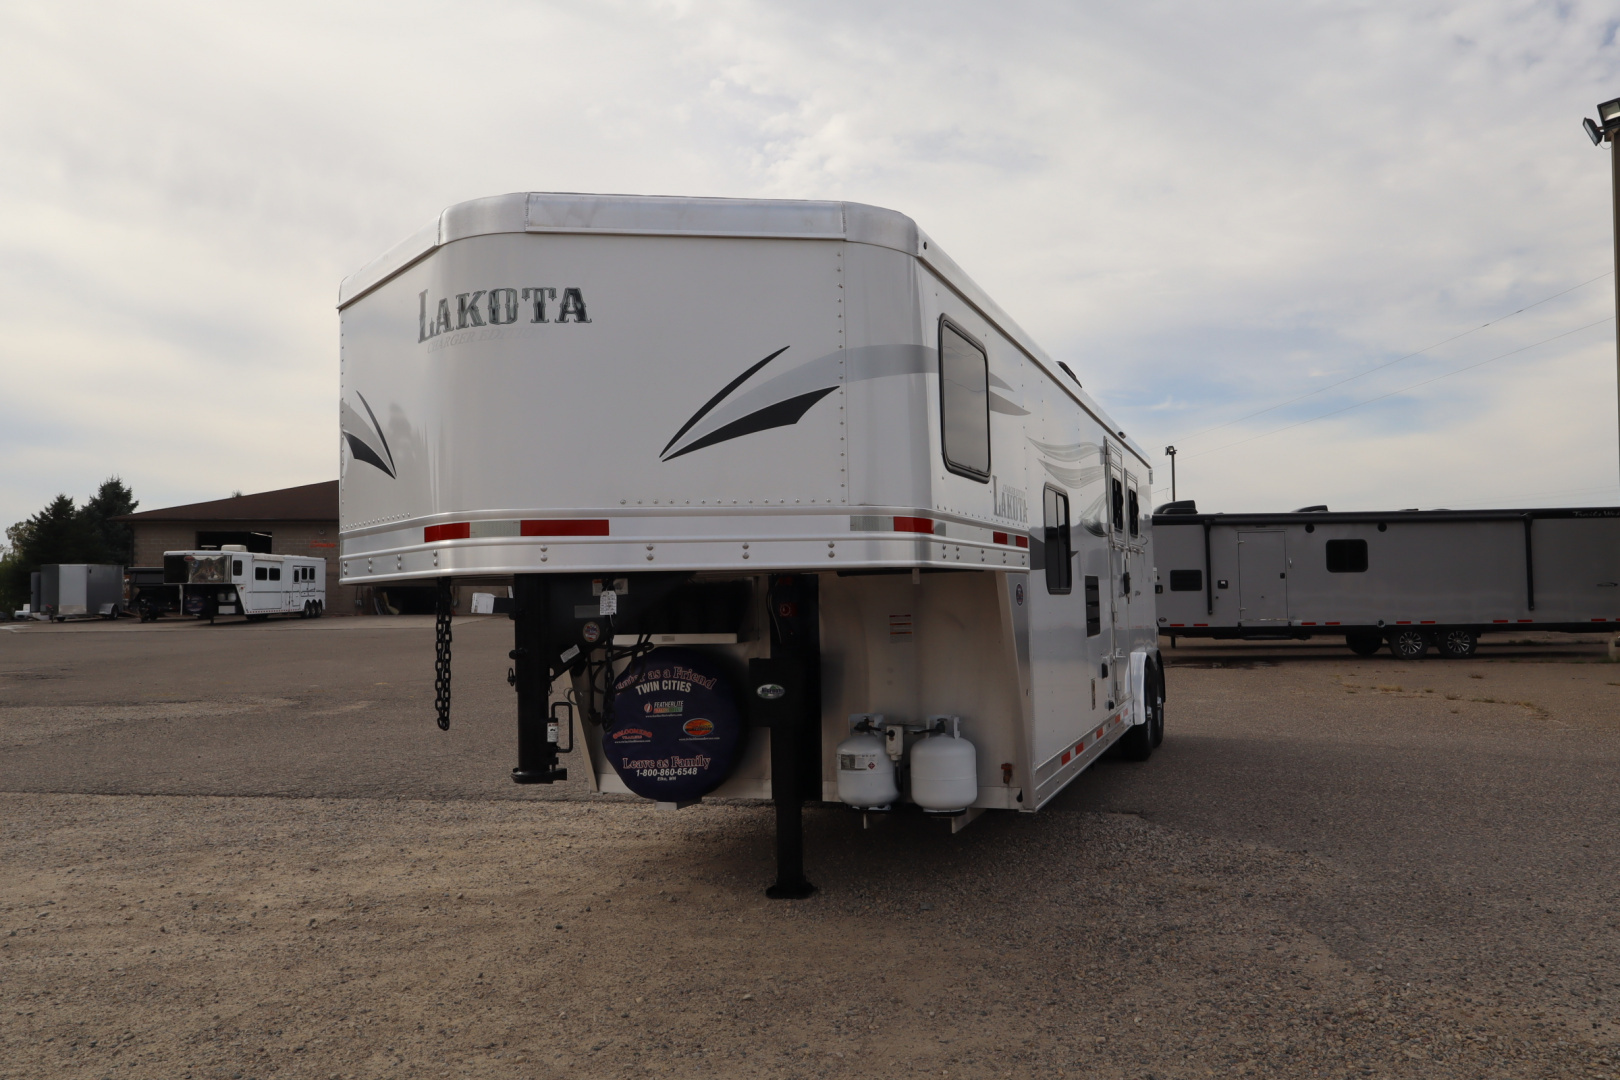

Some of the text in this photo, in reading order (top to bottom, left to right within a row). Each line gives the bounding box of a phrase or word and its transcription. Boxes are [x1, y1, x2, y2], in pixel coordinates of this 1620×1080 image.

[418, 287, 593, 343] LAKOTA
[992, 475, 1028, 523] LAKOTA
[647, 669, 661, 680] as
[663, 668, 671, 679] a
[673, 666, 717, 690] Friend
[635, 680, 692, 696] TWIN CITIES
[653, 700, 684, 709] FEATHERLITE
[622, 754, 711, 770] Leave as Family
[635, 767, 698, 777] 1-800-860-6548
